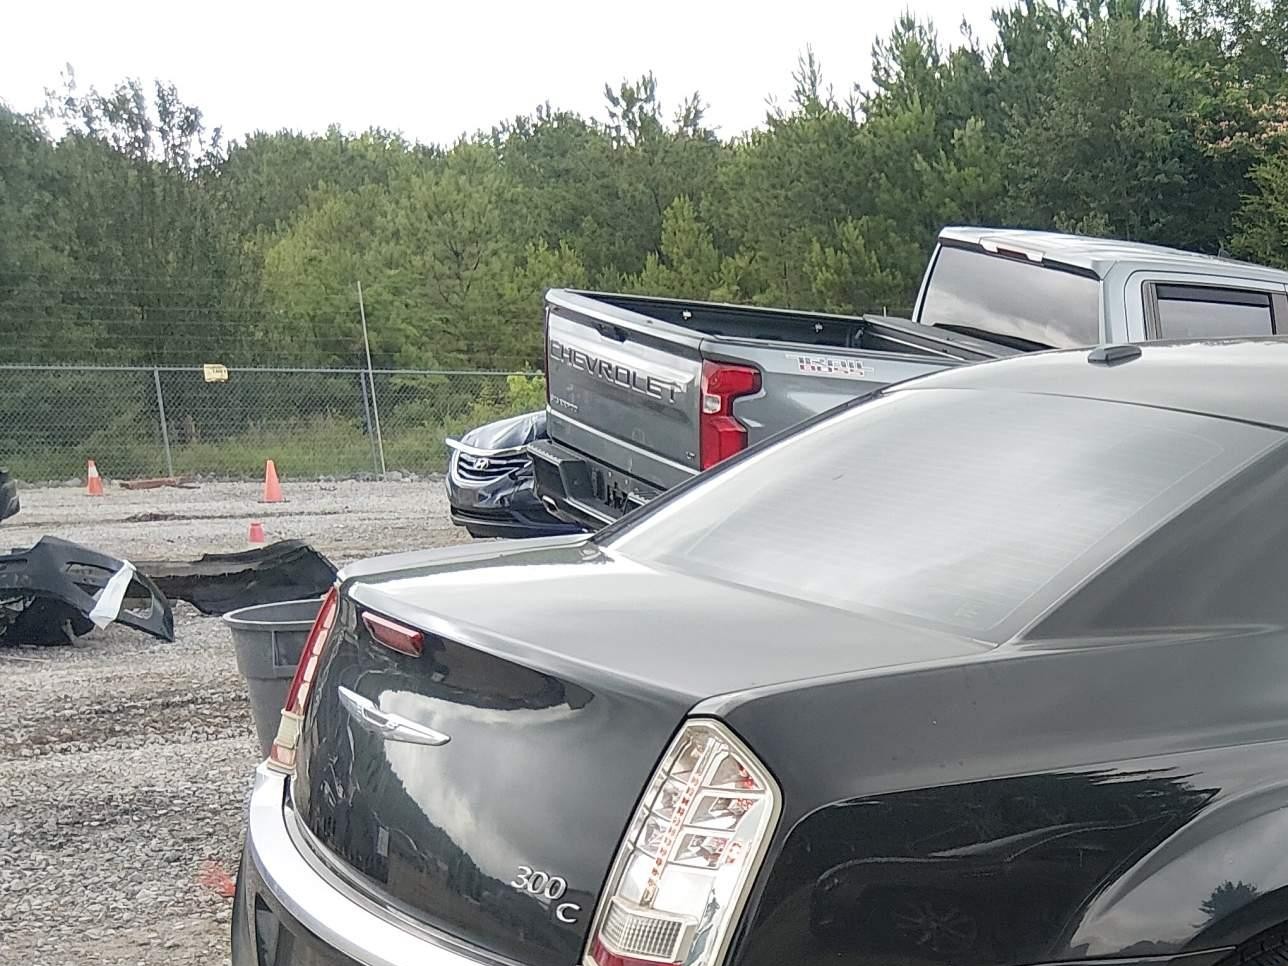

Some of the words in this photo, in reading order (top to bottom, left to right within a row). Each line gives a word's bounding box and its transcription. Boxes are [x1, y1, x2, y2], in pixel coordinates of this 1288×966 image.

[549, 339, 683, 405] CHEVROLET
[510, 865, 568, 901] 300
[555, 902, 582, 924] C
